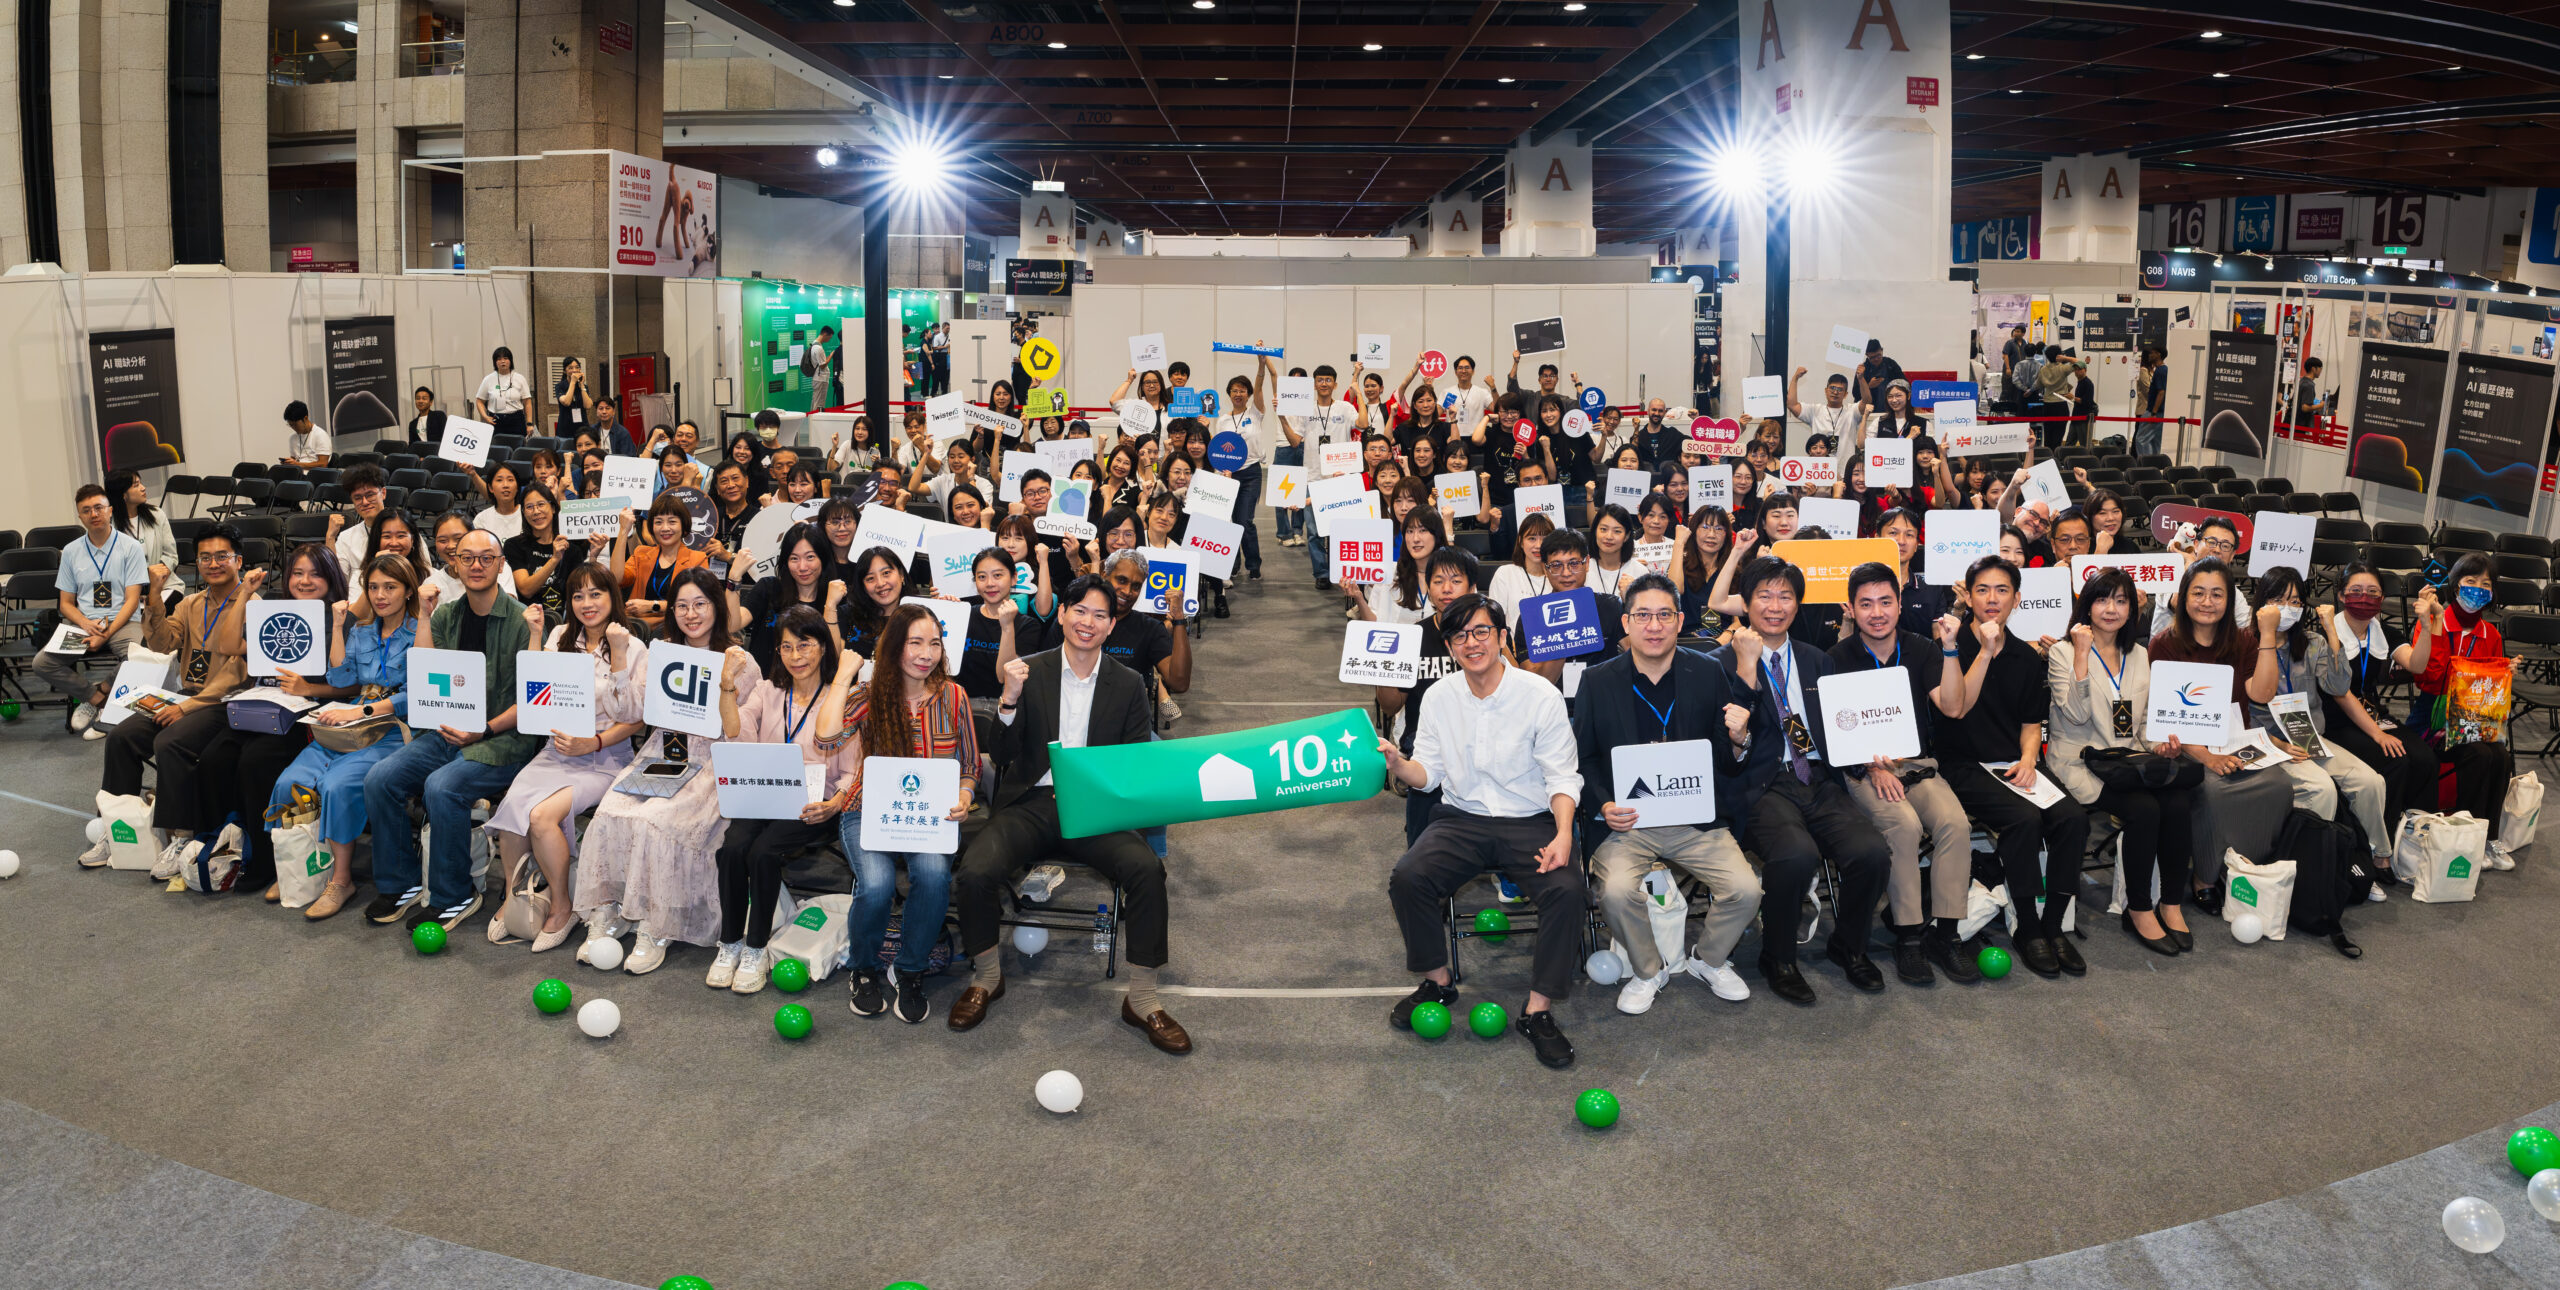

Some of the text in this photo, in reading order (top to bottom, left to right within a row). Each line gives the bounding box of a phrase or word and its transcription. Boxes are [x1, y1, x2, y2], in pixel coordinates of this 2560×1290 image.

[990, 24, 1044, 41] A800
[620, 164, 651, 180] JOIN US
[1540, 158, 1573, 191] A
[2053, 168, 2072, 200] A
[2100, 167, 2124, 198] A
[1035, 205, 1055, 227] A
[1449, 210, 1469, 232] A
[2377, 197, 2423, 242] 15
[2171, 207, 2203, 245] 16
[619, 225, 643, 247] B10
[1096, 230, 1112, 246] A
[1697, 232, 1711, 249] A
[1012, 271, 1067, 280] Cake AI 職缺分析
[2147, 266, 2196, 277] G08 NAVIS
[2303, 274, 2358, 285] G09 JTB Corp.
[333, 342, 342, 350] AI
[103, 356, 147, 370] AI 職缺分析
[1422, 357, 1444, 372] tft
[2216, 353, 2225, 363] AI
[2370, 369, 2406, 383] AI 求職信
[2466, 381, 2516, 399] AI 履歷健檢
[1695, 427, 1736, 440] 幸福職場
[1974, 434, 1998, 446] H2U
[453, 433, 478, 450] CDS
[1687, 443, 1743, 455] SOGO最大心
[1326, 451, 1357, 461] 新光三越
[1805, 471, 1835, 480] SOGO
[1193, 487, 1230, 504] Schneider
[563, 500, 611, 510] JOIN US!
[1328, 498, 1363, 510] DECATHLON
[1525, 503, 1555, 513] onelab
[566, 514, 620, 527] PEGATRO
[1036, 519, 1094, 536] Omnichat
[865, 530, 908, 548] CORNING
[1365, 543, 1381, 552] UNI
[2260, 541, 2305, 554] 星野リゾート
[1365, 552, 1381, 561] QLO
[1149, 571, 1184, 591] GU
[1342, 565, 1385, 583] UMC
[2103, 565, 2175, 582] 匠教育
[1153, 596, 1198, 613] GC
[1532, 626, 1598, 647] 華城電機
[1533, 637, 1599, 655] FORTUNE ELECTRIC
[1346, 658, 1413, 673] 華城電機
[1345, 668, 1413, 681] FORTUNE ELECTRIC
[417, 699, 476, 711] TALENT TAIWAN
[1861, 705, 1902, 720] NTU-OIA
[729, 777, 803, 787] 臺北市就業服務處
[1275, 775, 1353, 797] Anniversary
[1656, 774, 1702, 791] Lam
[1656, 788, 1702, 798] RESEARCH
[892, 800, 930, 811] 教育部
[879, 813, 940, 827] 青年發展署
